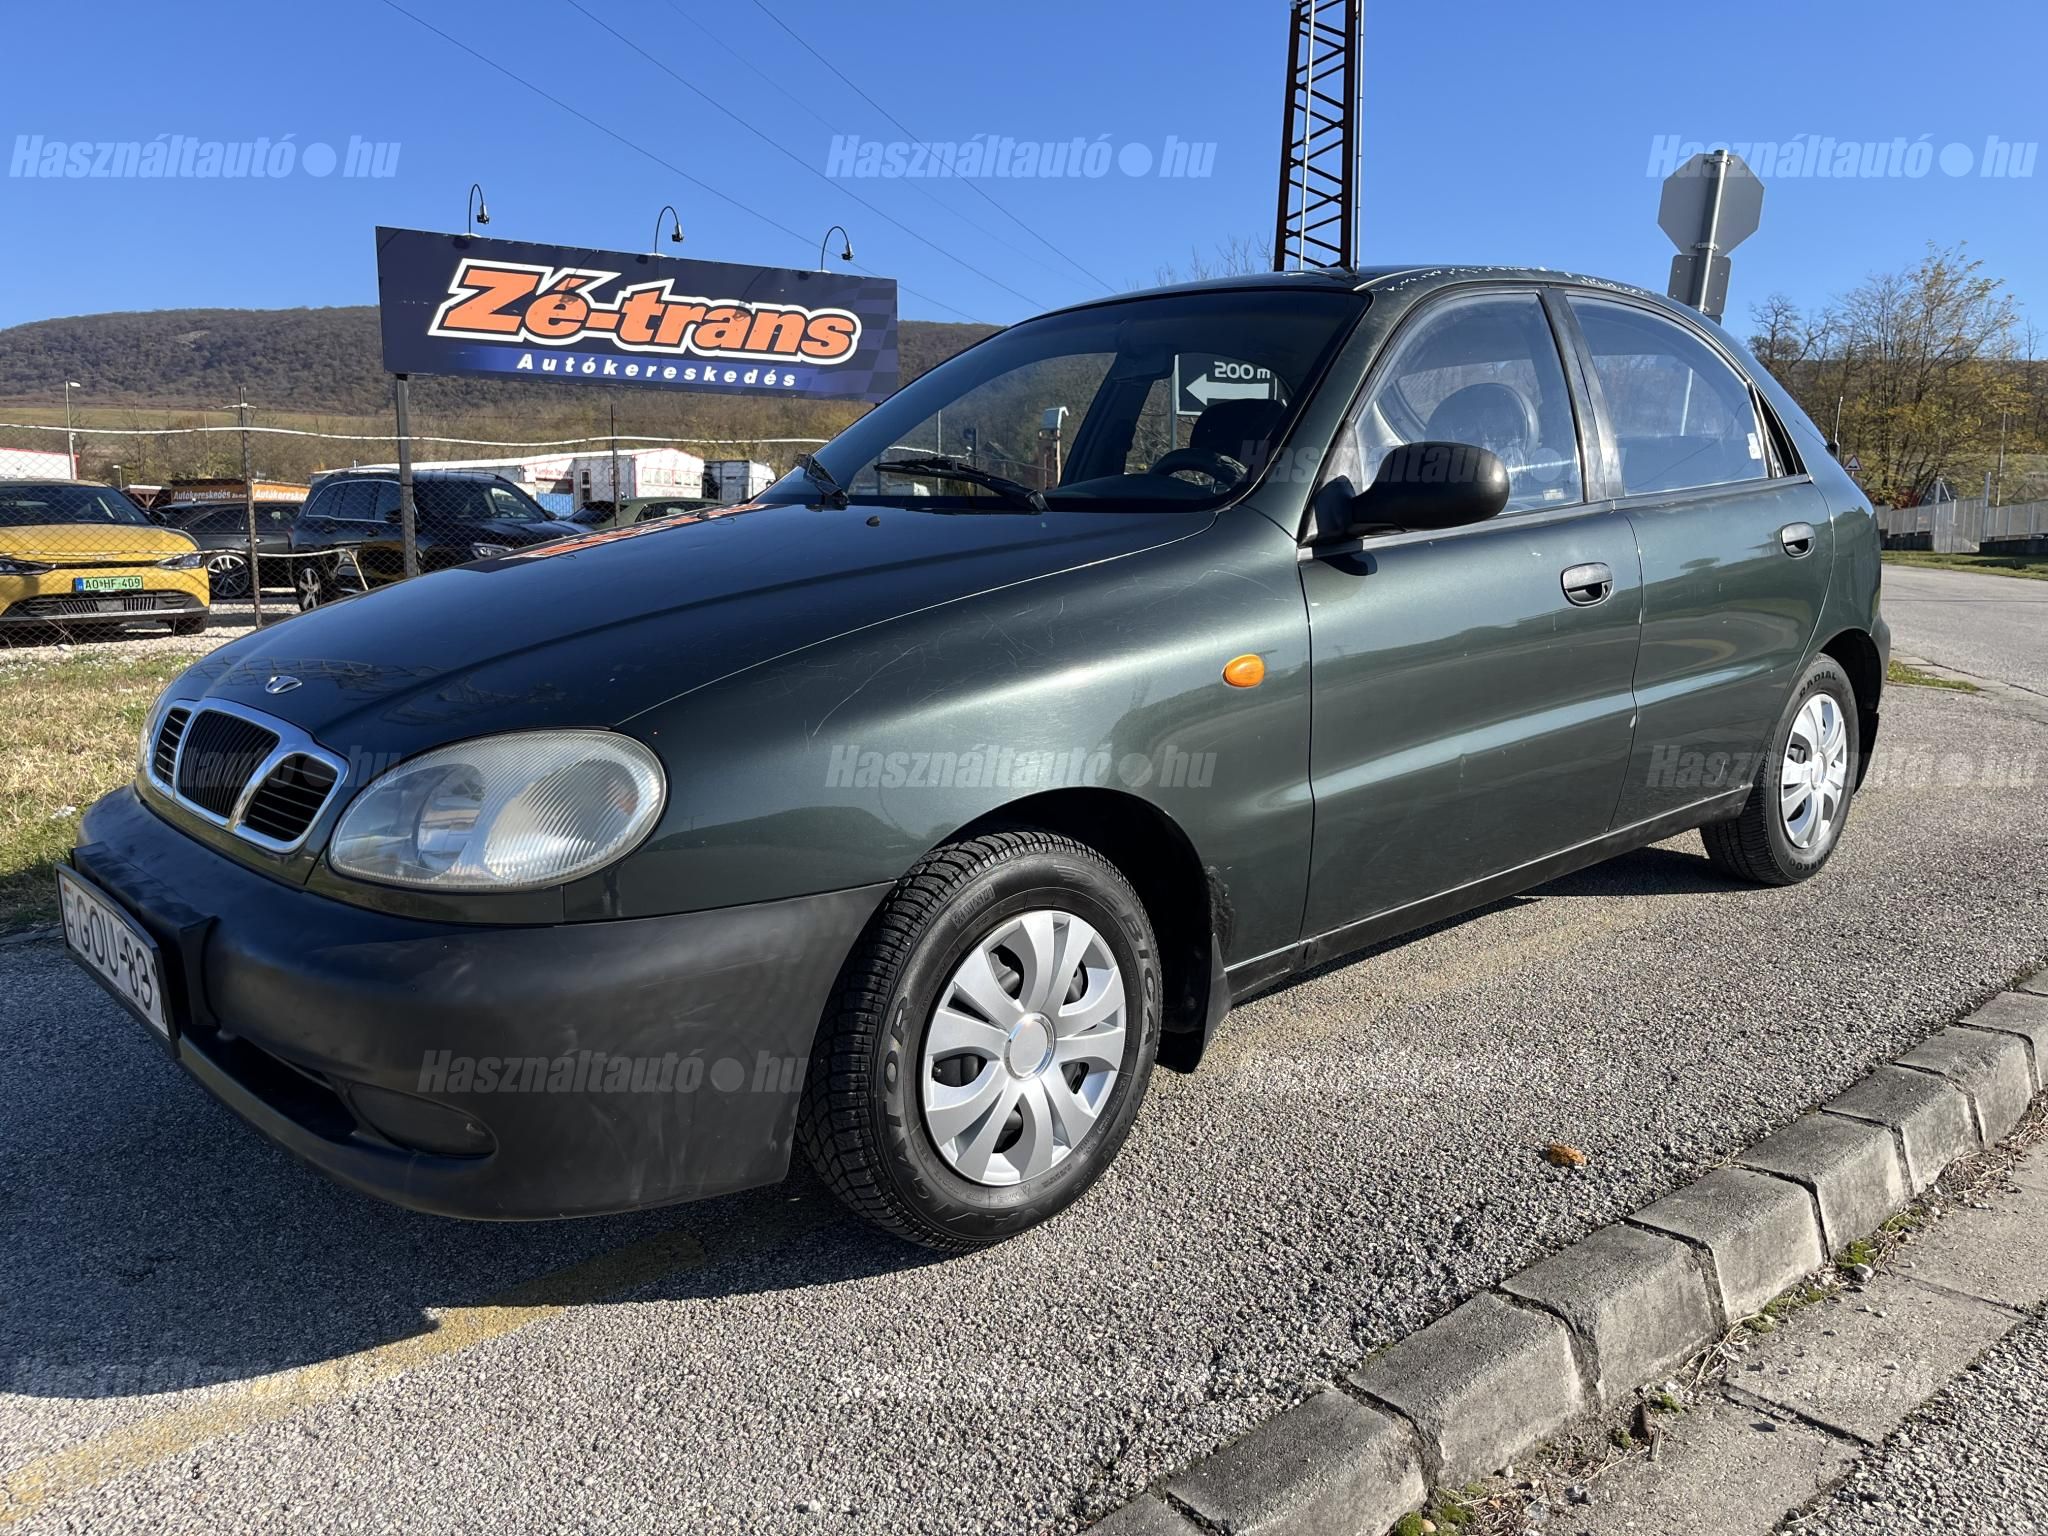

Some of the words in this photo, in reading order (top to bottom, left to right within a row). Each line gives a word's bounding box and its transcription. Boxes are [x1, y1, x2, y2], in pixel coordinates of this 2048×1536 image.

[430, 260, 863, 364] Zé-trans
[517, 353, 797, 387] Autókereskedés
[1214, 361, 1255, 380] 200
[1257, 368, 1271, 379] m
